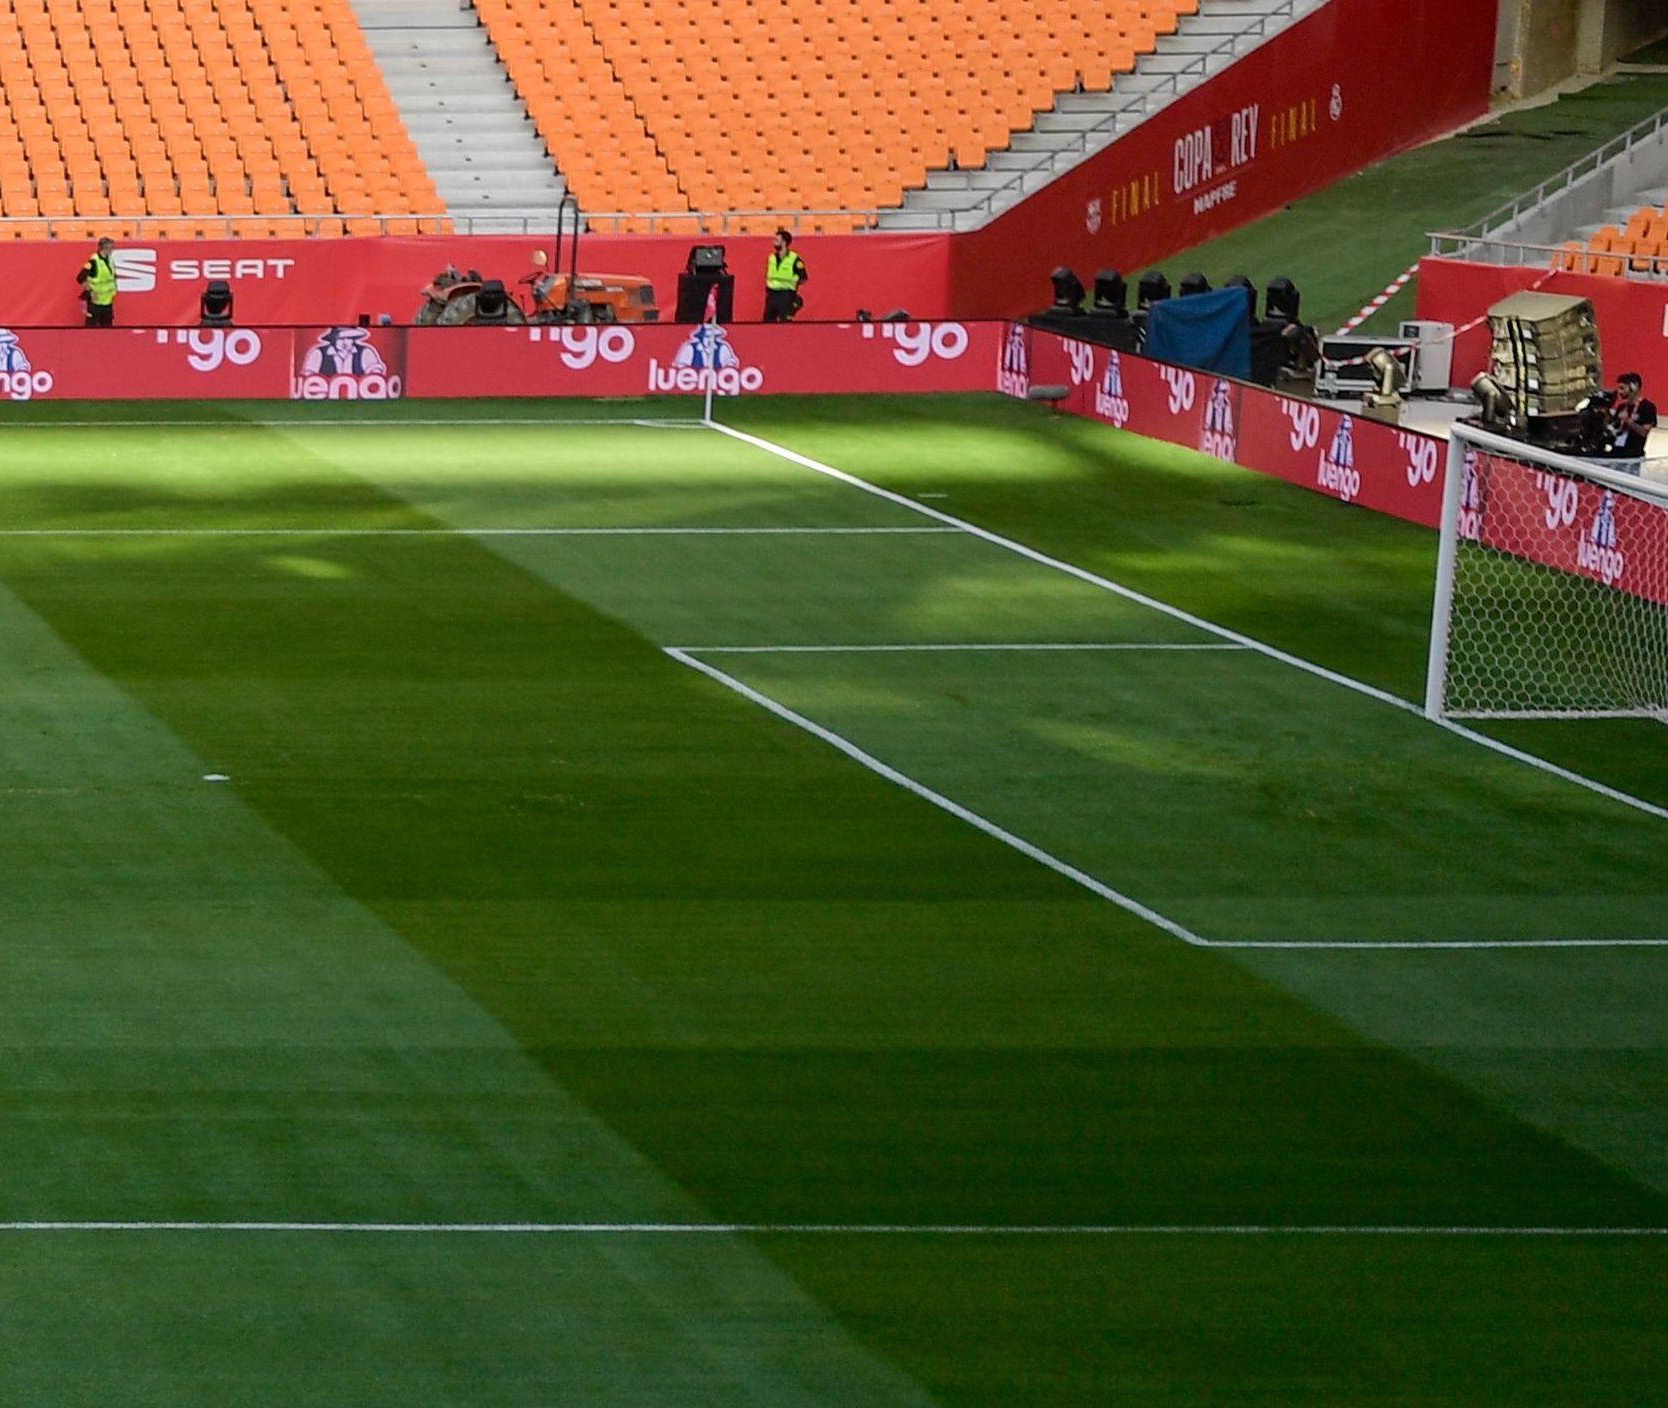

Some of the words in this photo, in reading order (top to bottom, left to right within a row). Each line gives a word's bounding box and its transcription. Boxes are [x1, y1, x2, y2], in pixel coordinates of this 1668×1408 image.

[1174, 126, 1212, 194] COPA
[1231, 104, 1259, 167] REY
[170, 259, 295, 280] SEAT
[648, 358, 763, 396] luengo
[1318, 449, 1361, 501] luengo
